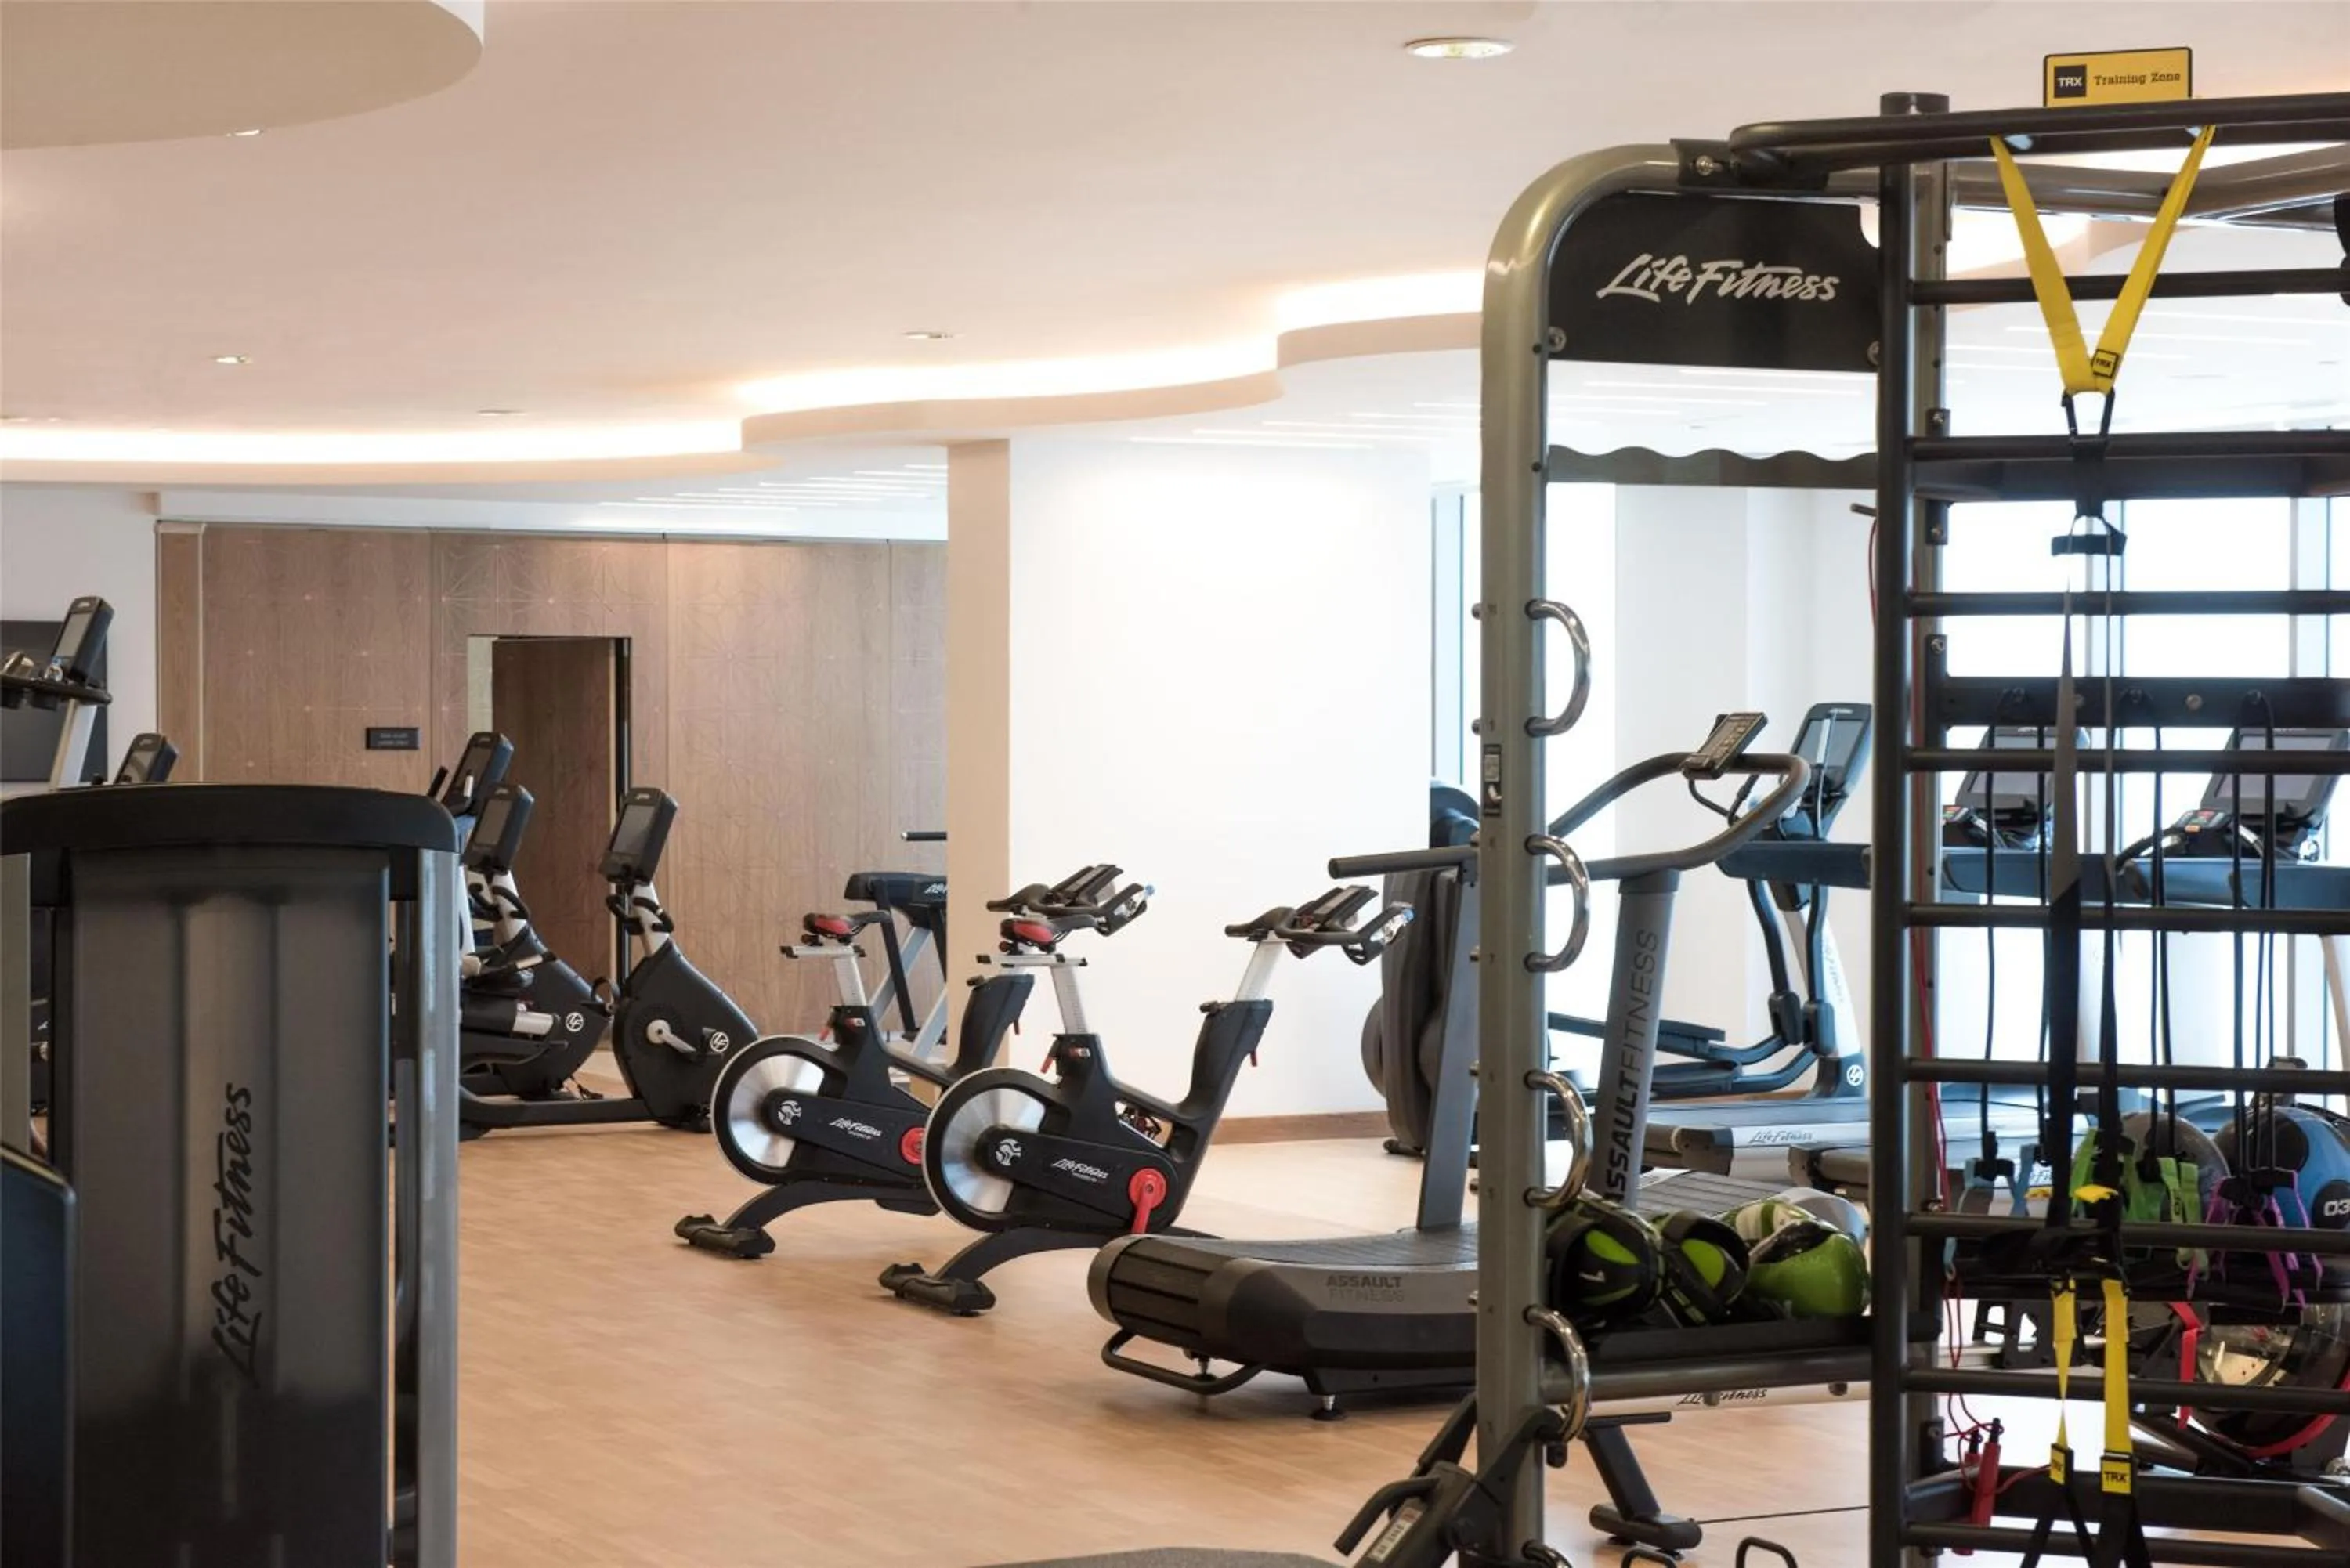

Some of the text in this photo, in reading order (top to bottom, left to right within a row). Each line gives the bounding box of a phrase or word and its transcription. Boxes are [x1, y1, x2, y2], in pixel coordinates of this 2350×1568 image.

[2057, 76, 2083, 88] TRX
[2093, 71, 2181, 86] Training Zone
[1325, 1276, 1403, 1288] ASSAULT
[1329, 1288, 1405, 1302] FITNESS
[2104, 1471, 2128, 1483] TRX
